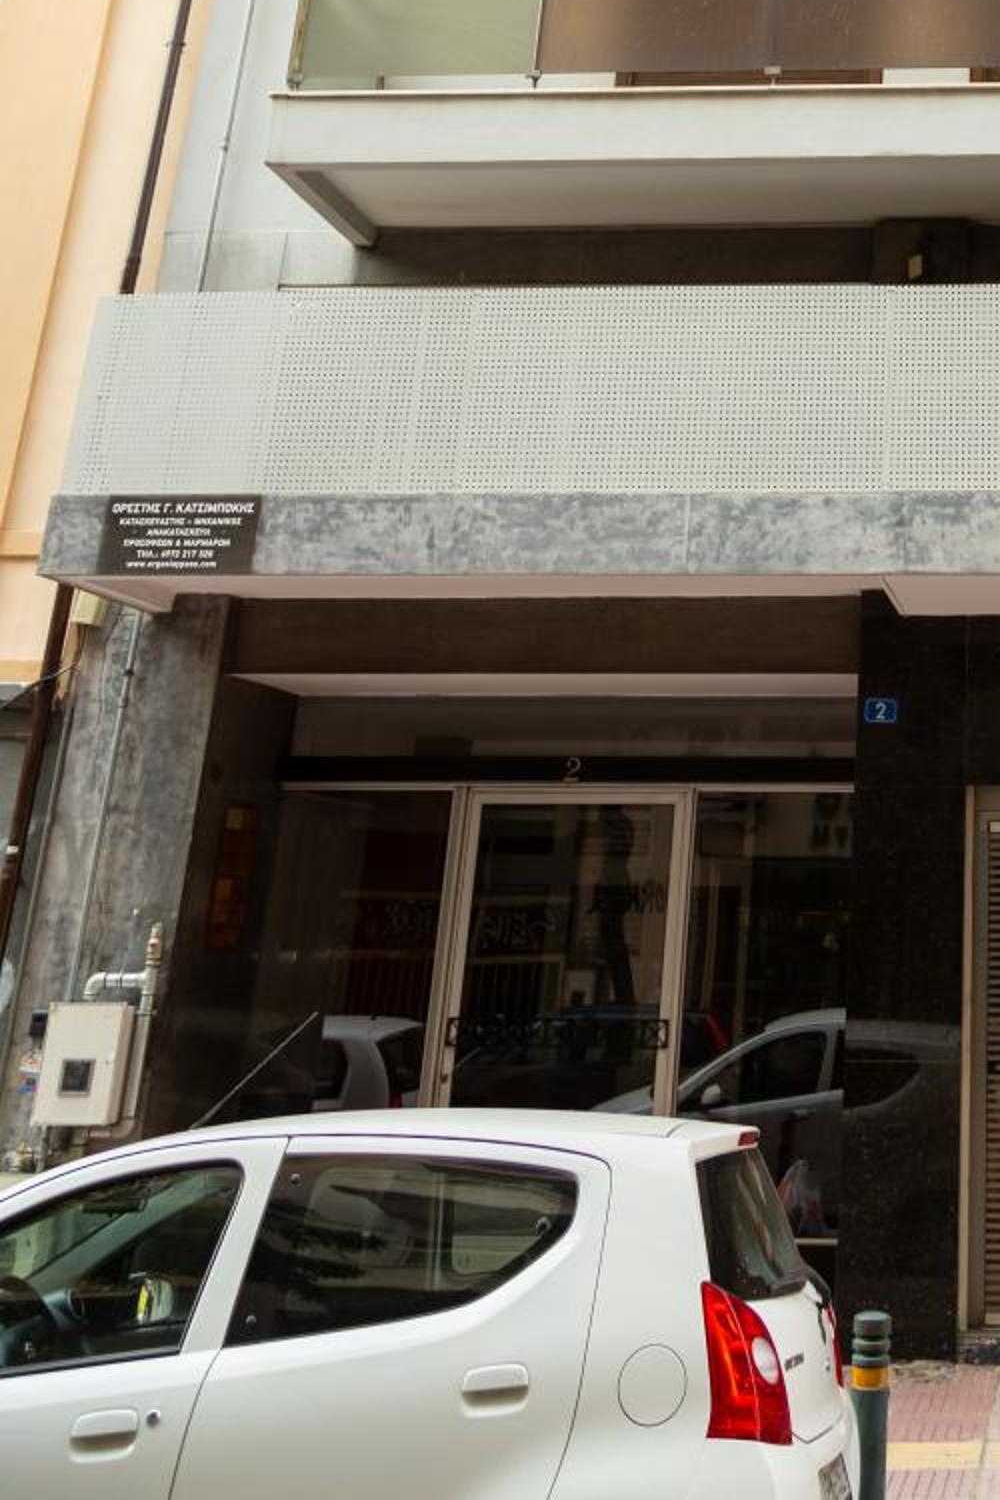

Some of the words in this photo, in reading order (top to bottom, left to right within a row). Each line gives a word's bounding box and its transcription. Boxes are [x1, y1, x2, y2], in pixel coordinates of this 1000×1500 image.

[112, 502, 161, 514] ΟΡΕΣΤΗΣ
[163, 502, 174, 514] Γ.
[875, 702, 886, 720] 2
[564, 757, 582, 783] 2
